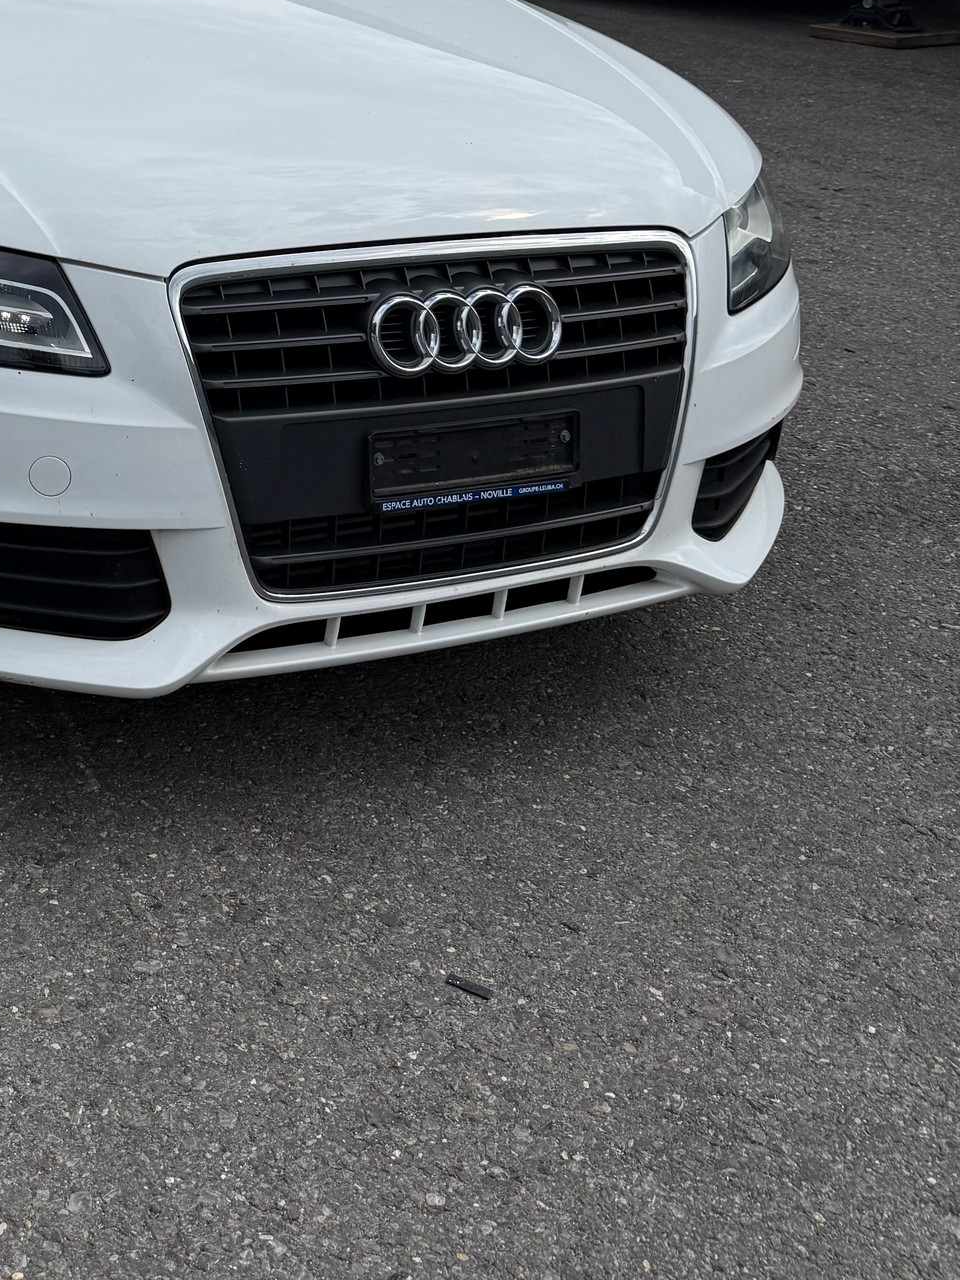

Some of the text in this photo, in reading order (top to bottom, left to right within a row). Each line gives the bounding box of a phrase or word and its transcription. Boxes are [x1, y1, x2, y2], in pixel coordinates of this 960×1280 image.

[382, 500, 411, 511] ESPACE
[412, 497, 435, 508] AUTO
[436, 493, 473, 504] CHABLAIS
[480, 488, 513, 500] NOVILLE
